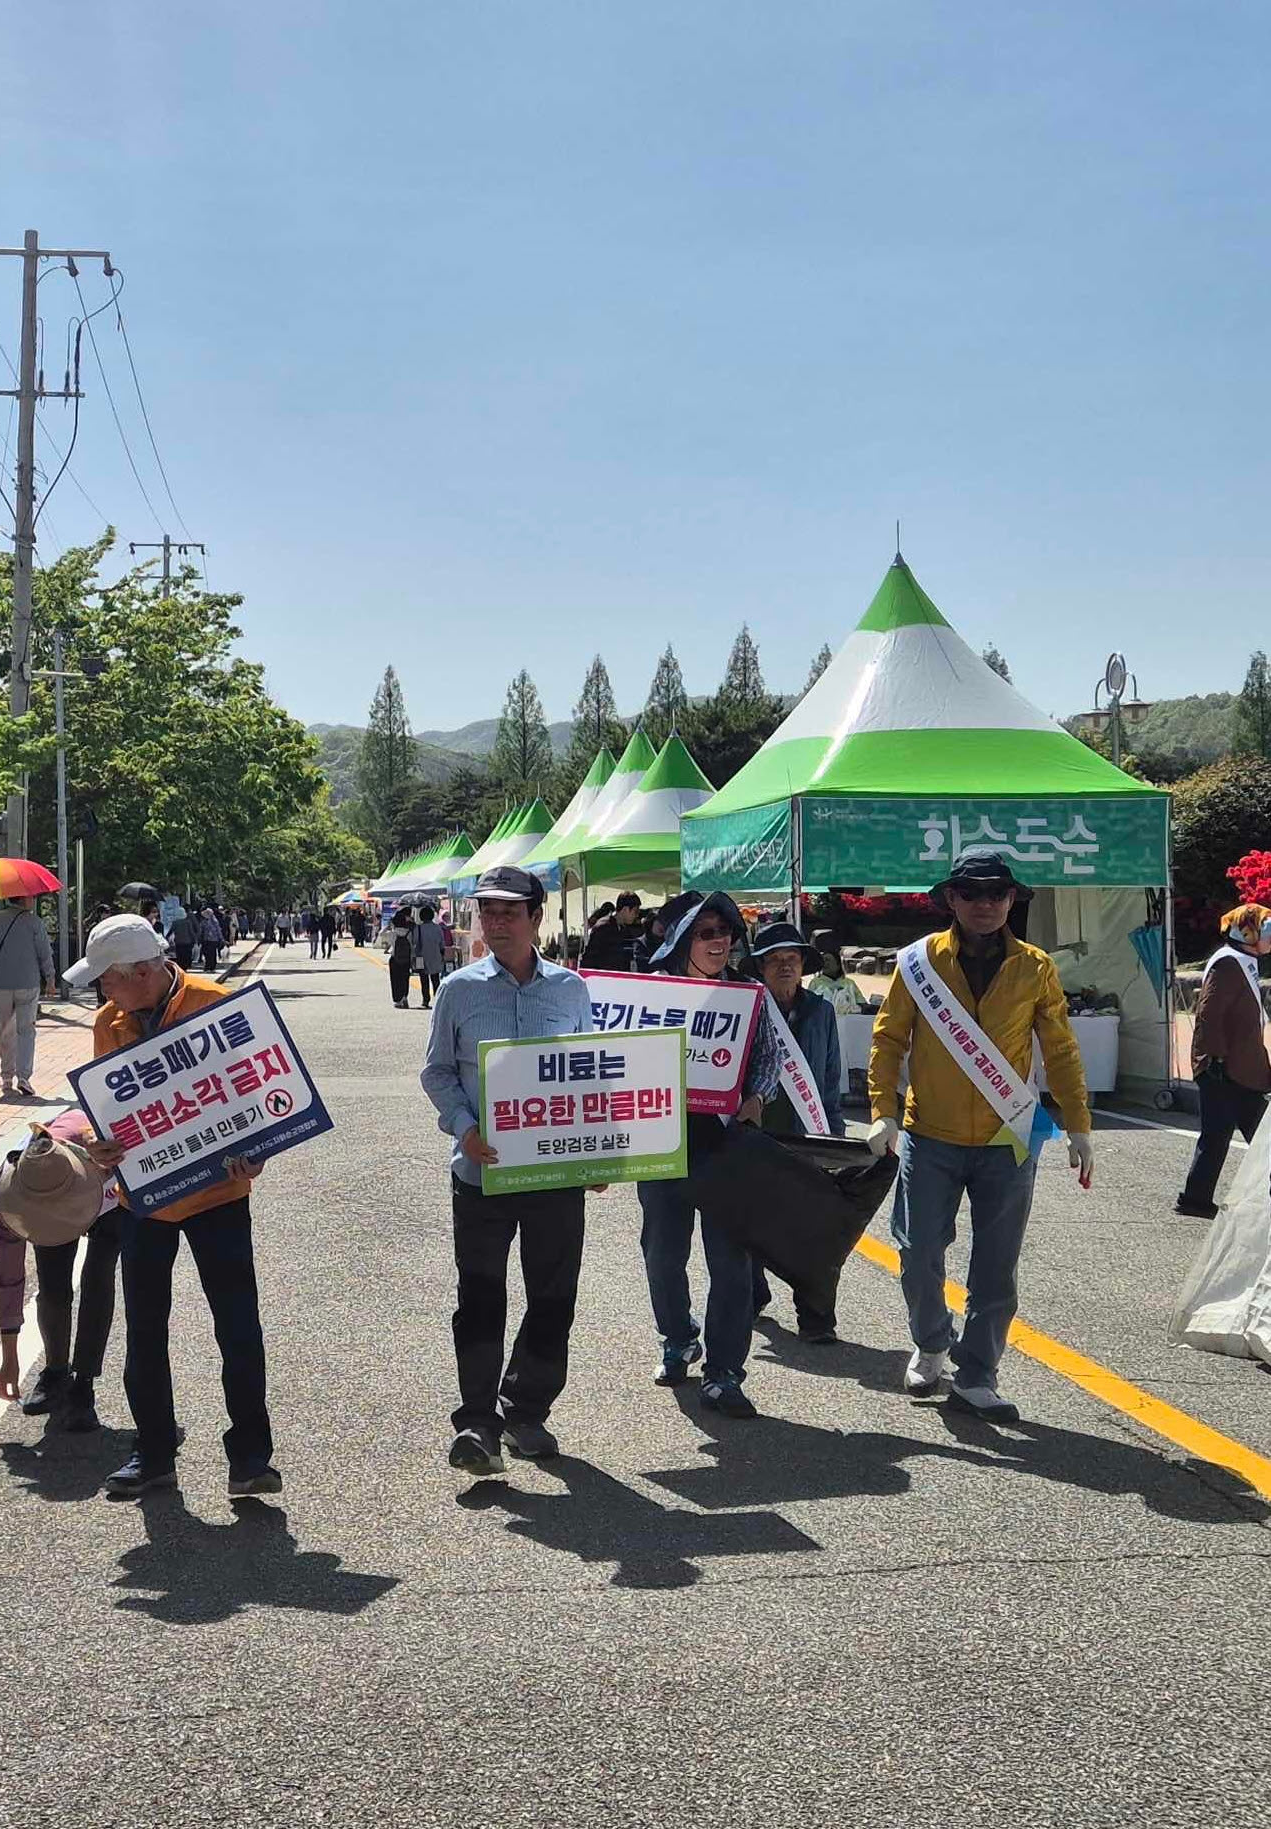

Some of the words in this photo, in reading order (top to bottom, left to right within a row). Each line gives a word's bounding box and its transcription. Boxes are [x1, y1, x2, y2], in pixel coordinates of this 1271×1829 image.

[691, 1010, 741, 1041] 떼기
[920, 984, 942, 1010] 대응
[937, 1006, 978, 1056] 탄소중립
[105, 1010, 256, 1103] 영농폐기물
[538, 1050, 626, 1083] 비료는
[108, 1073, 230, 1152] 불법소각
[226, 1043, 292, 1097] 금지
[492, 1096, 576, 1132] 필요한
[583, 1087, 672, 1124] 만큼만!
[138, 1142, 186, 1174] 깨끗한
[218, 1104, 264, 1138] 만들기
[537, 1136, 597, 1155] 토양검정
[601, 1133, 631, 1151] 실천
